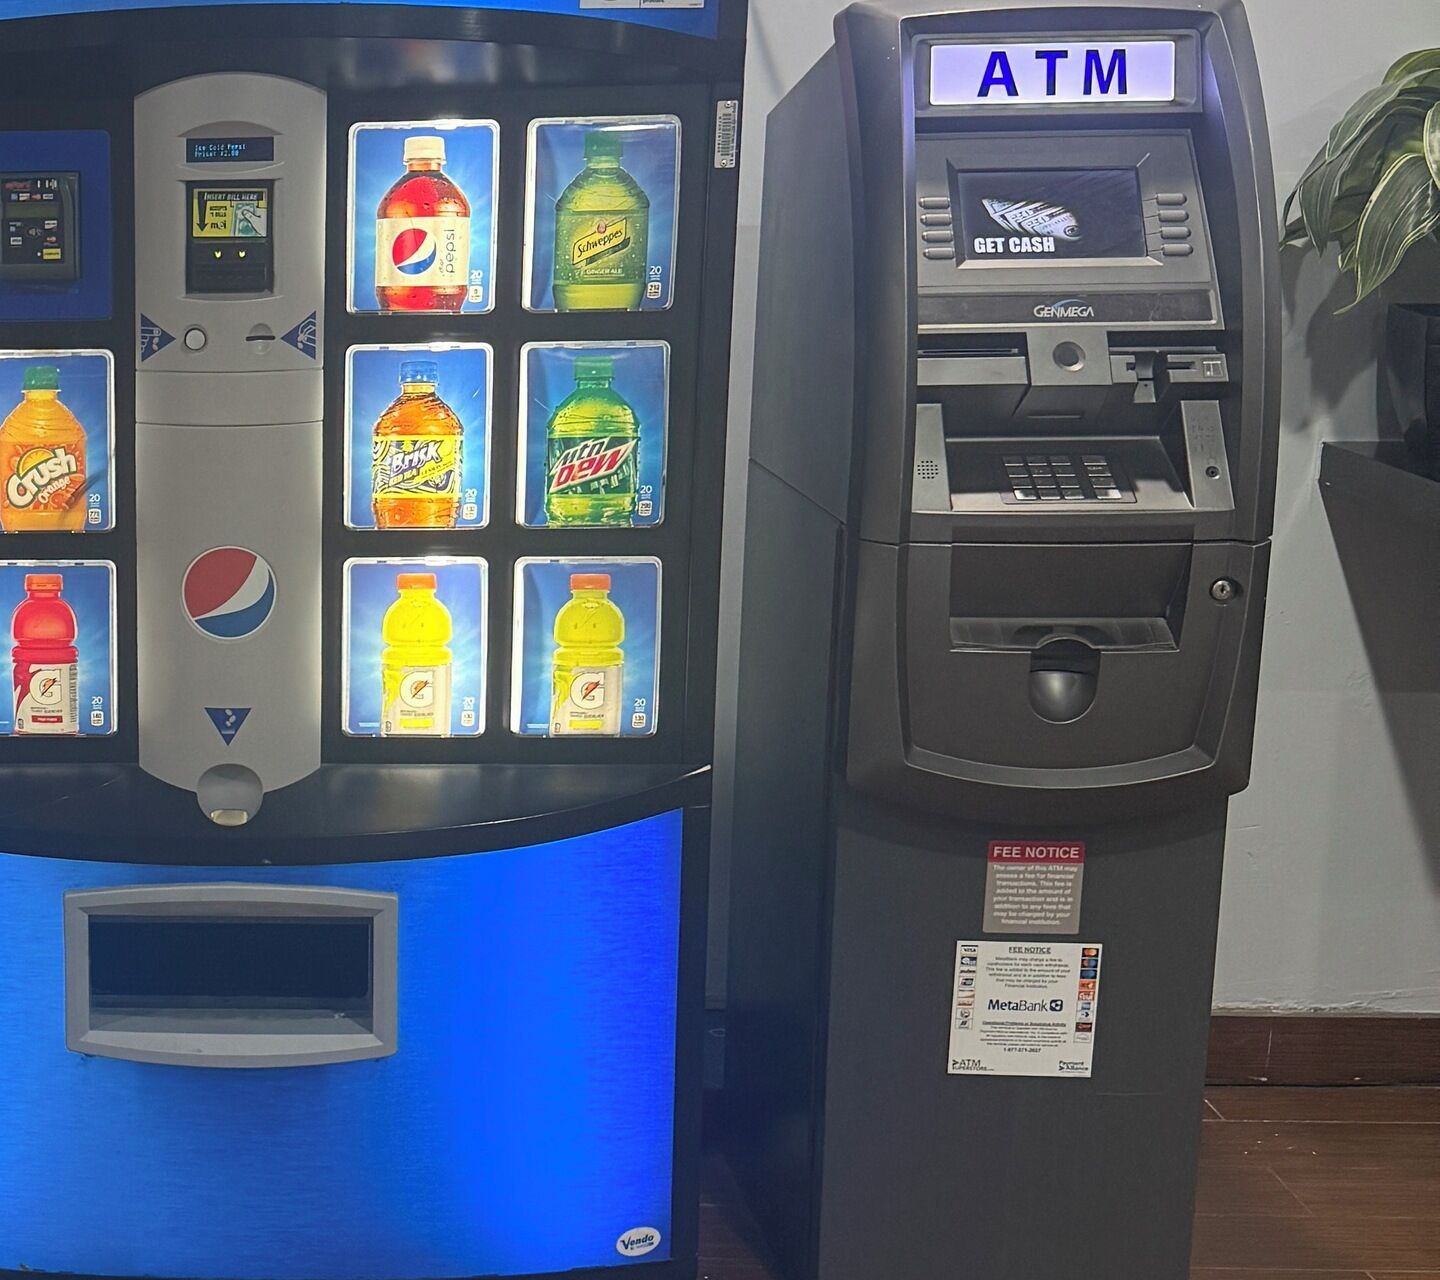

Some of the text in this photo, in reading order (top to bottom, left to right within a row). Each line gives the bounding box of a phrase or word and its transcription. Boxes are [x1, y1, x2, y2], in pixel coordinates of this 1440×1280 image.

[977, 48, 1128, 98] ATM
[204, 192, 225, 200] INSERT
[577, 229, 623, 258] Schweppes
[974, 236, 1055, 253] GET CASH
[443, 229, 457, 274] pepsi
[470, 269, 483, 279] 20
[649, 266, 662, 275] 20
[1033, 304, 1095, 318] GENMEGA
[391, 441, 442, 473] Brisk
[7, 447, 77, 507] Crush
[38, 475, 71, 504] Orange
[464, 488, 478, 497] 20
[640, 485, 653, 494] 20
[89, 494, 101, 502] 20
[29, 668, 62, 706] G
[400, 670, 434, 708] G
[570, 671, 606, 710] G
[91, 697, 103, 705] 20
[463, 696, 475, 706] 20
[634, 698, 646, 707] 20
[993, 846, 1080, 859] FEE NOTICE
[1009, 946, 1023, 954] FEE
[988, 999, 1049, 1012] MetaBank
[620, 1233, 654, 1250] Vendo
